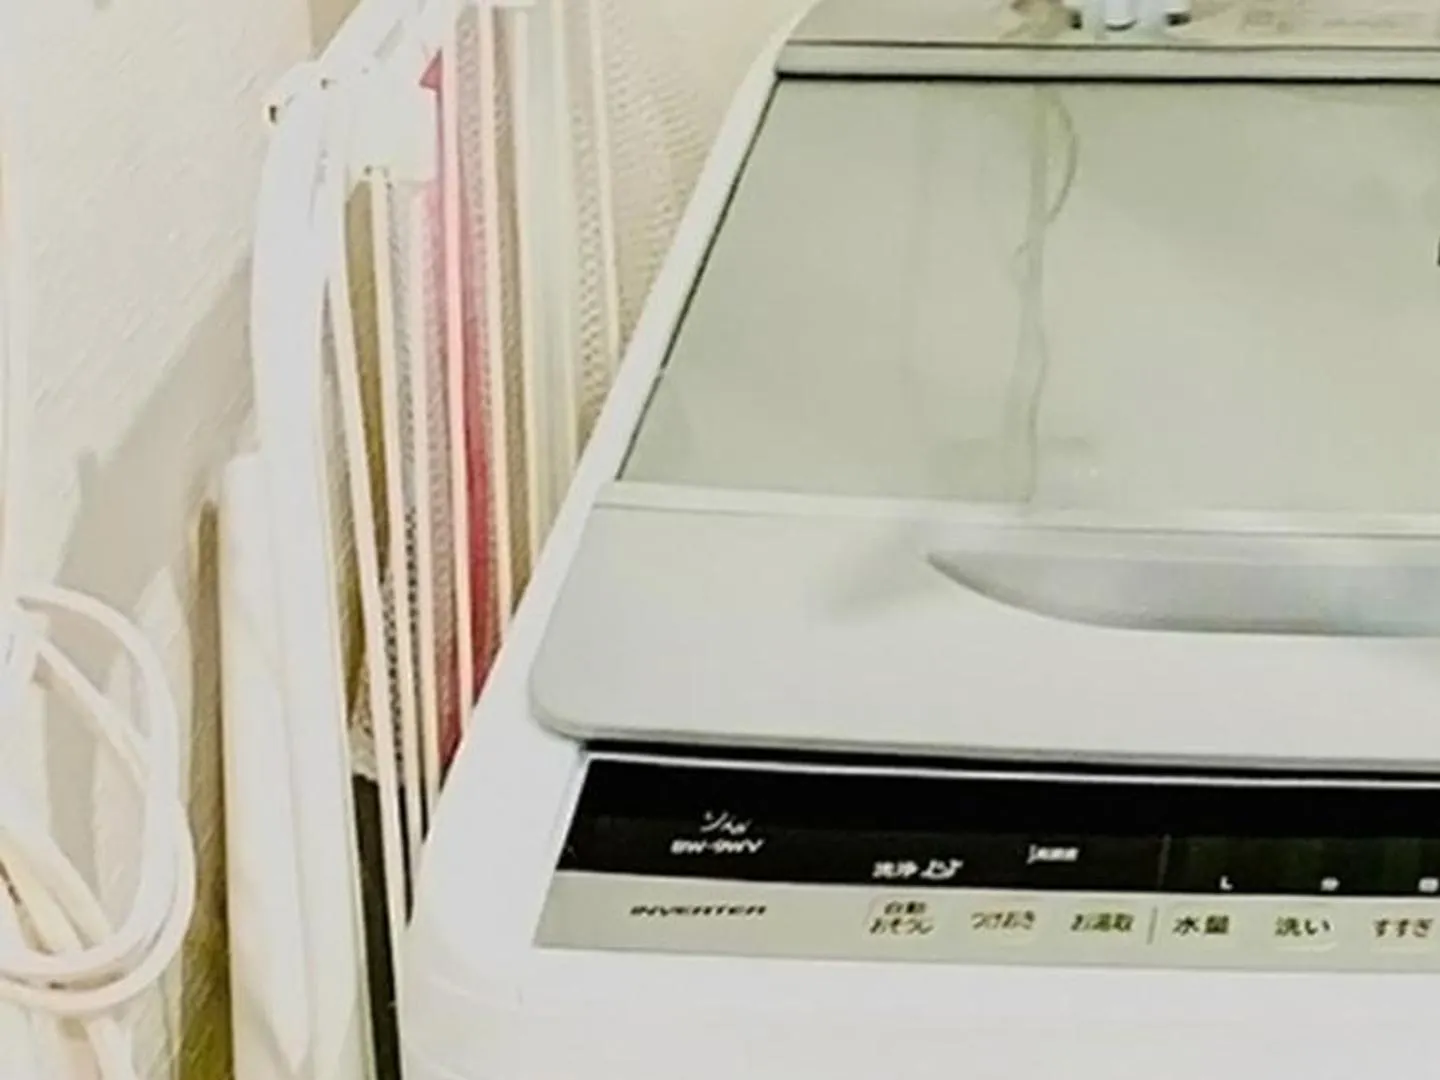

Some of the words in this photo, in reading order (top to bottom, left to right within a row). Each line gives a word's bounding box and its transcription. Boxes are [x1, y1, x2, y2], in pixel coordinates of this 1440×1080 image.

[630, 906, 767, 916] INVERTER
[1173, 915, 1230, 935] 水量
[1275, 917, 1331, 937] 洗い
[1374, 918, 1433, 938] すすぎ
